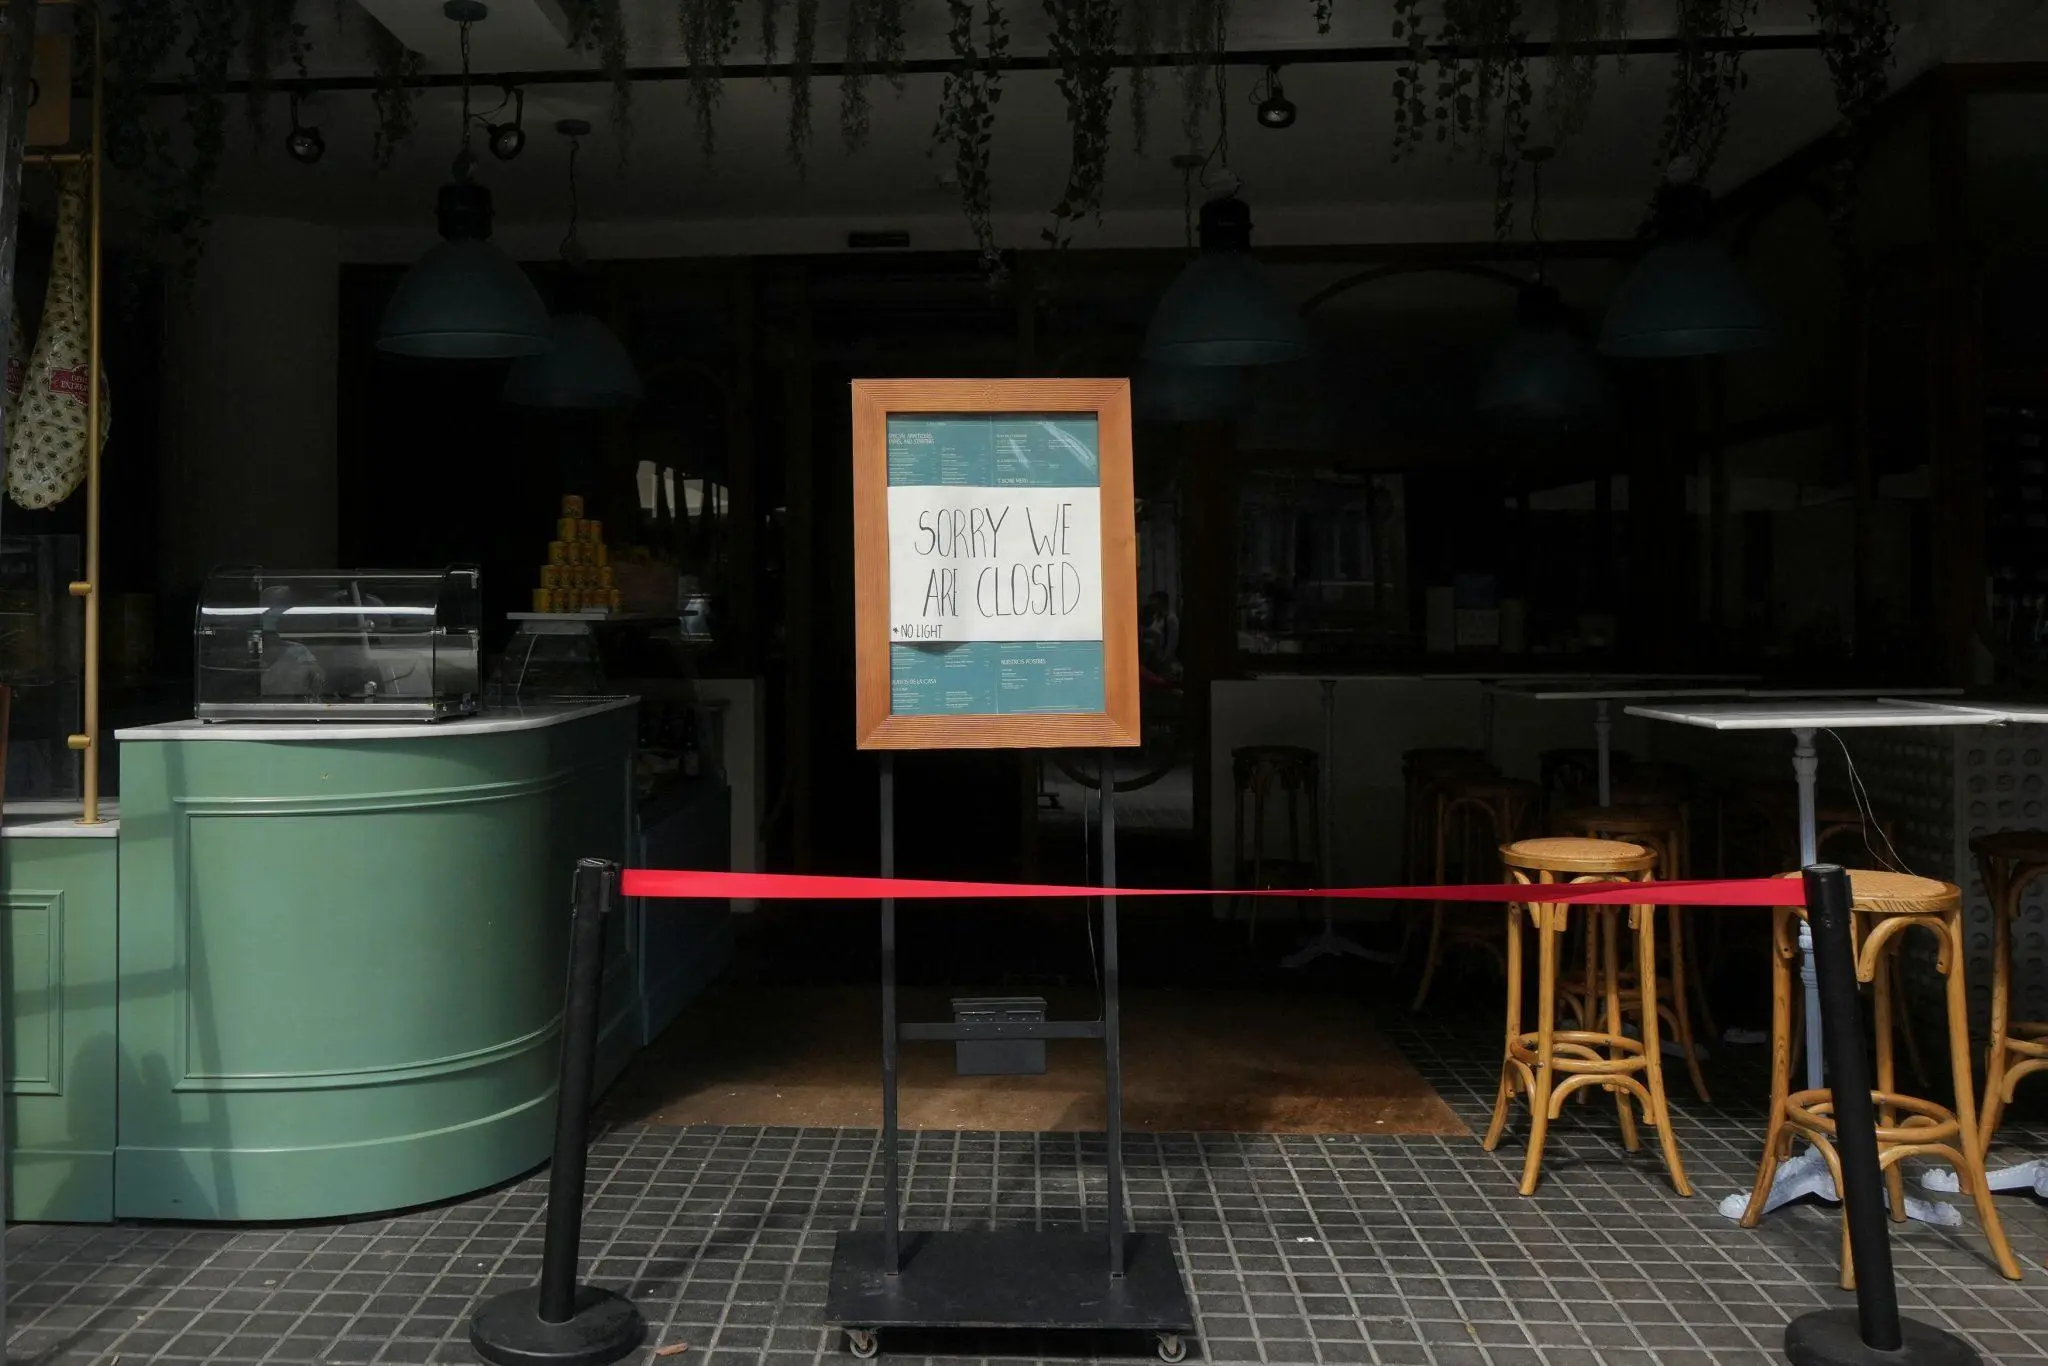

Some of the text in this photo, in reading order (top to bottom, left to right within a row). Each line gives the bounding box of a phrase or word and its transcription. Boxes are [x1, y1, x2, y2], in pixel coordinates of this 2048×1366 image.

[914, 503, 1073, 559] SORRY WE
[922, 561, 1081, 618] ARE CLOSED
[915, 623, 943, 639] LIGHT
